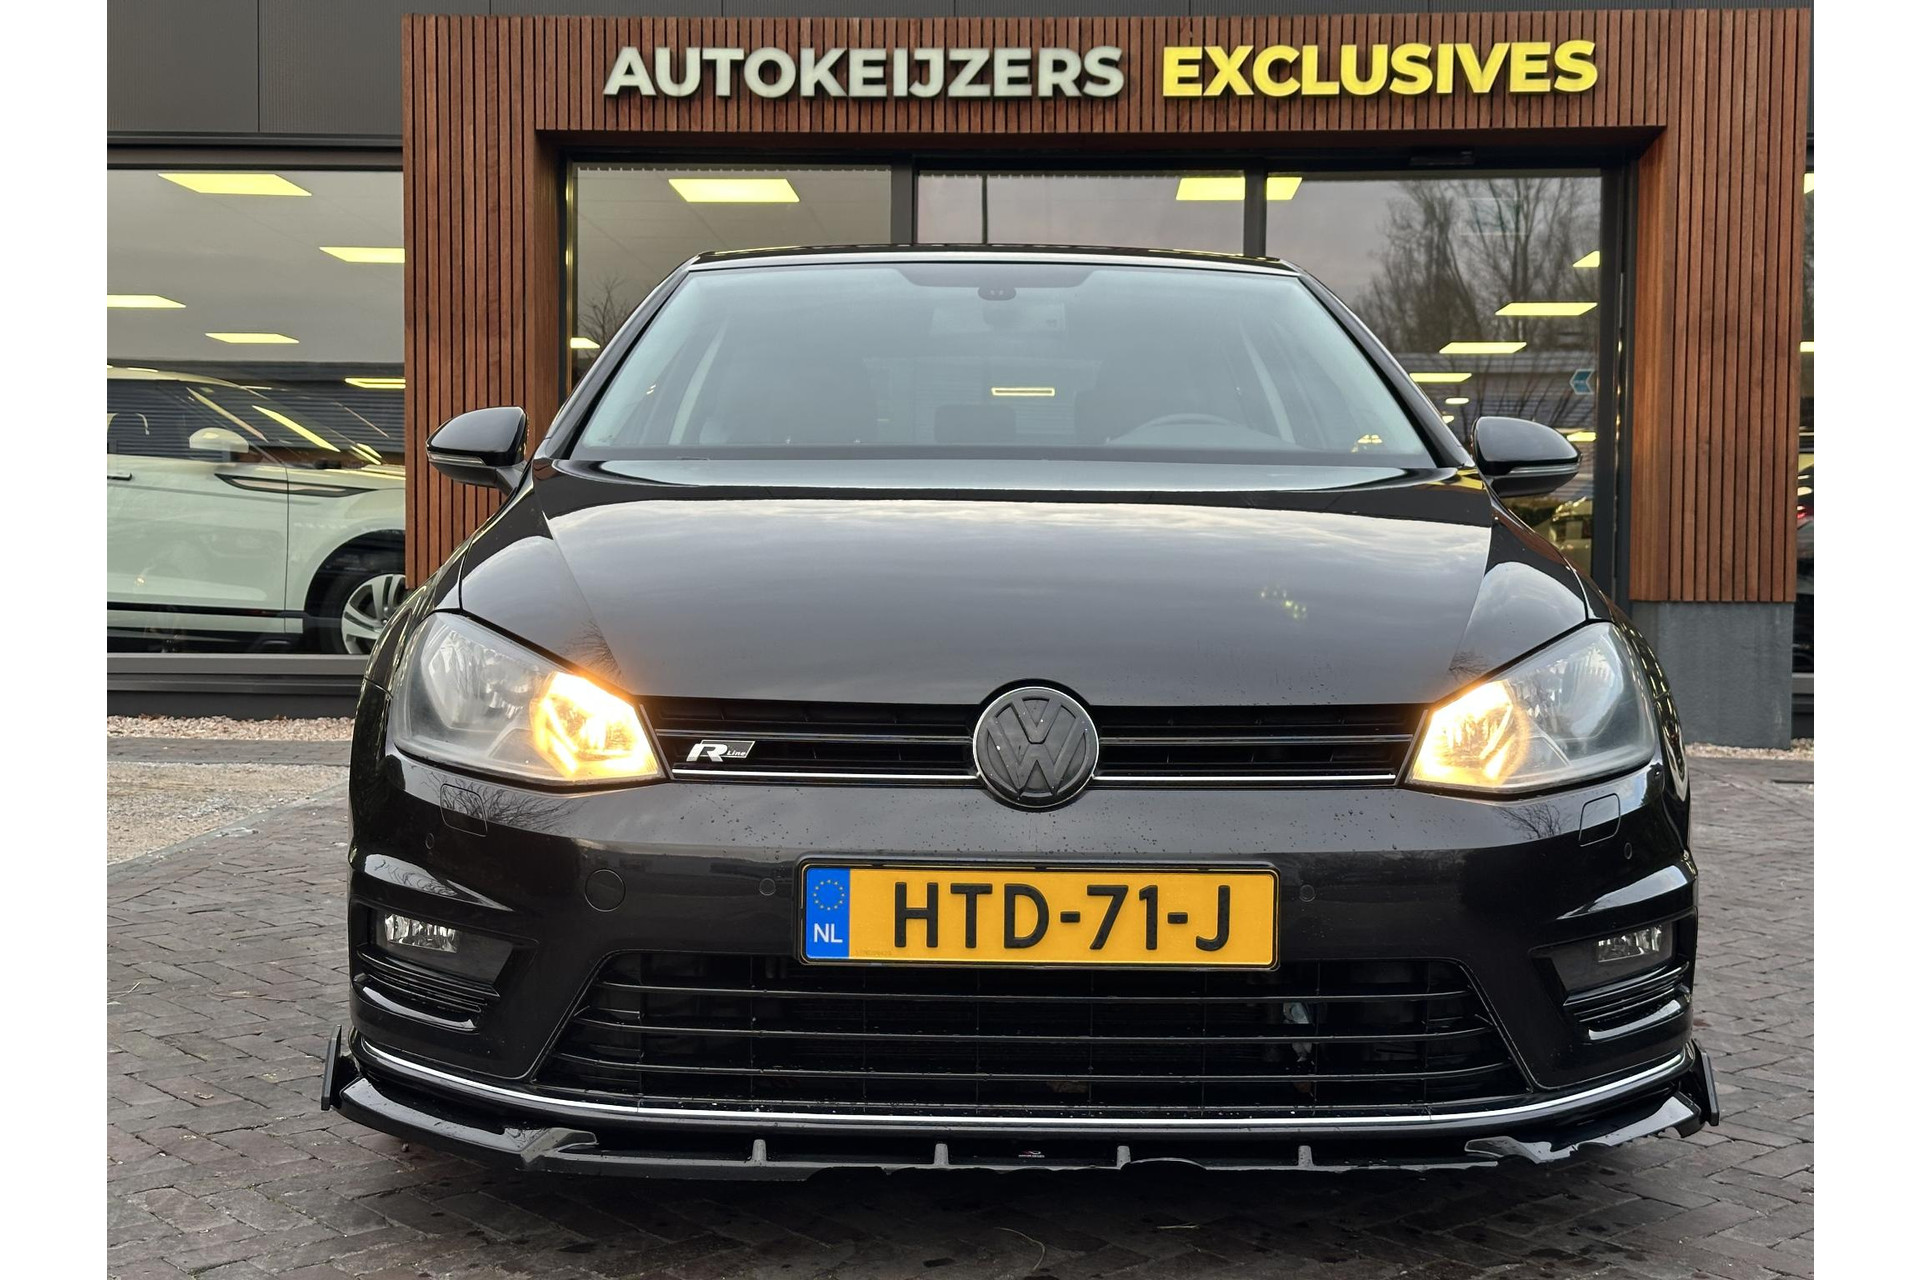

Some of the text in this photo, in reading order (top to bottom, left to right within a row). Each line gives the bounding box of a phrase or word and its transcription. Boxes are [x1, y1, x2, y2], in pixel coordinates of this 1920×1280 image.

[603, 39, 1598, 98] AUTOKEIJZERS EXCLUSIVES
[686, 743, 728, 762] R
[813, 923, 843, 943] NL
[894, 881, 1231, 951] HTD-71-J
